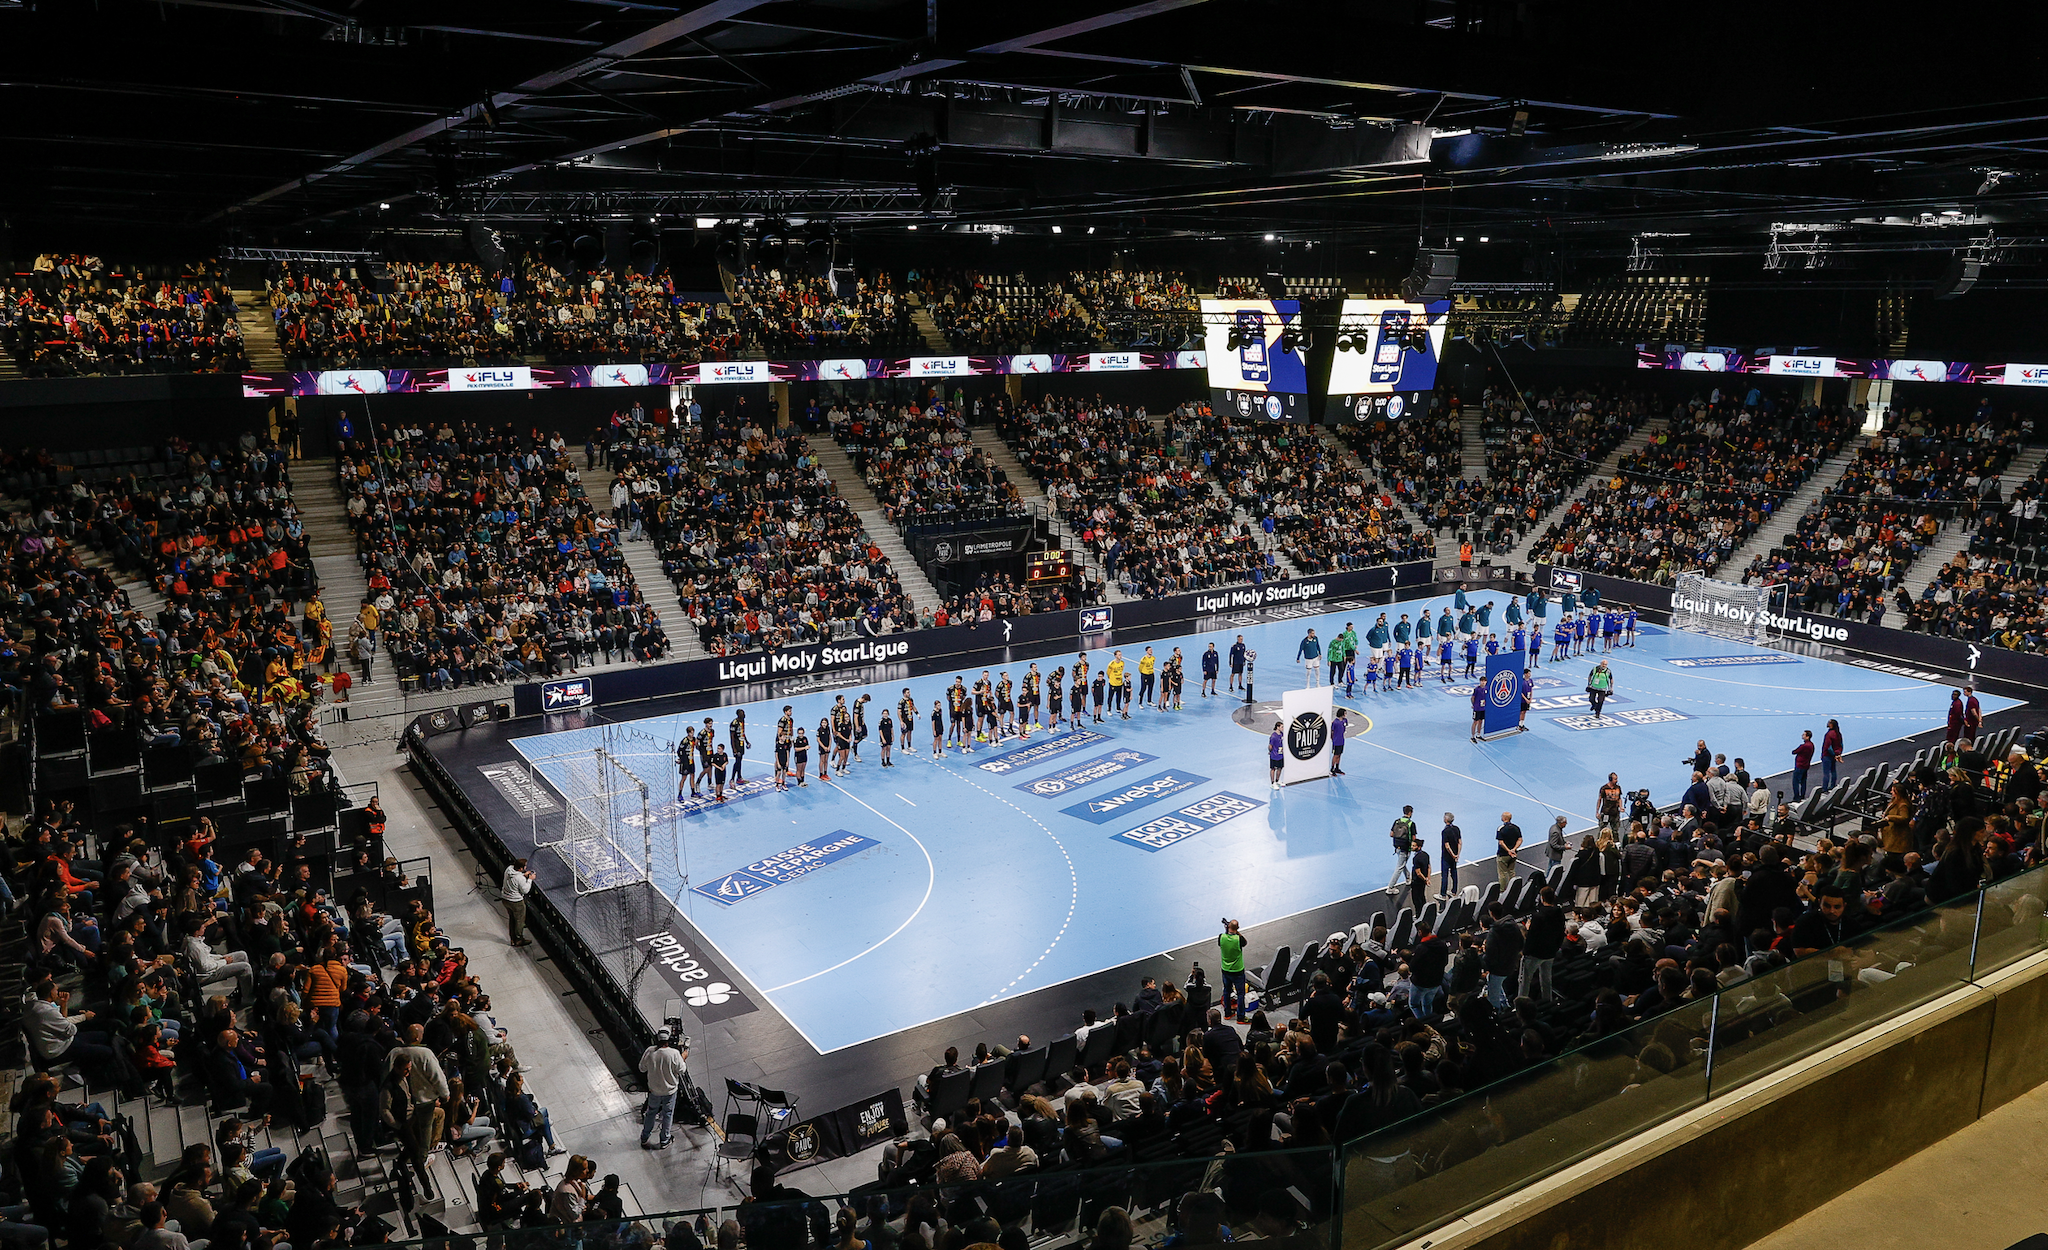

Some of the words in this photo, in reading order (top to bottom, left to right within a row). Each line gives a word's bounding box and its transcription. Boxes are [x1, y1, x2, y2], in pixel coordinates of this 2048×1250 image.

[931, 360, 956, 369] iFLY
[1107, 356, 1129, 364] iFLY
[1792, 360, 1821, 369] iFLY
[478, 371, 513, 382] iFLY
[724, 366, 754, 375] iFLY
[1226, 390, 1232, 401] 0
[1289, 394, 1295, 407] 0
[1345, 395, 1351, 407] 0
[1412, 392, 1419, 403] 0
[1034, 569, 1040, 578] 0
[1061, 567, 1066, 576] 0
[1196, 592, 1229, 612] Liqui
[1231, 588, 1263, 606] Moly
[1265, 582, 1326, 602] StarLigue
[1670, 593, 1710, 614] Liqui
[1714, 601, 1755, 625] Moly
[1758, 610, 1849, 641] StarLigue
[719, 656, 766, 681] Liqui
[771, 650, 817, 673] Moly
[821, 641, 909, 665] StarLigue
[1004, 730, 1097, 764] LAMETROPOLE
[1296, 729, 1318, 748] PAUC
[1104, 775, 1180, 805] weber
[1183, 796, 1233, 816] LIQUI
[1202, 801, 1251, 822] MOLY
[1126, 818, 1180, 840] LIQUI
[1146, 823, 1197, 846] MOLY
[747, 843, 817, 872] CAISSE
[760, 835, 864, 877] D'EPARGNE
[777, 860, 826, 882] CEPAC
[636, 930, 709, 982] actual
[860, 1104, 885, 1124] ENJOY
[866, 1117, 890, 1138] FUTURE
[795, 1136, 813, 1154] PAUC
